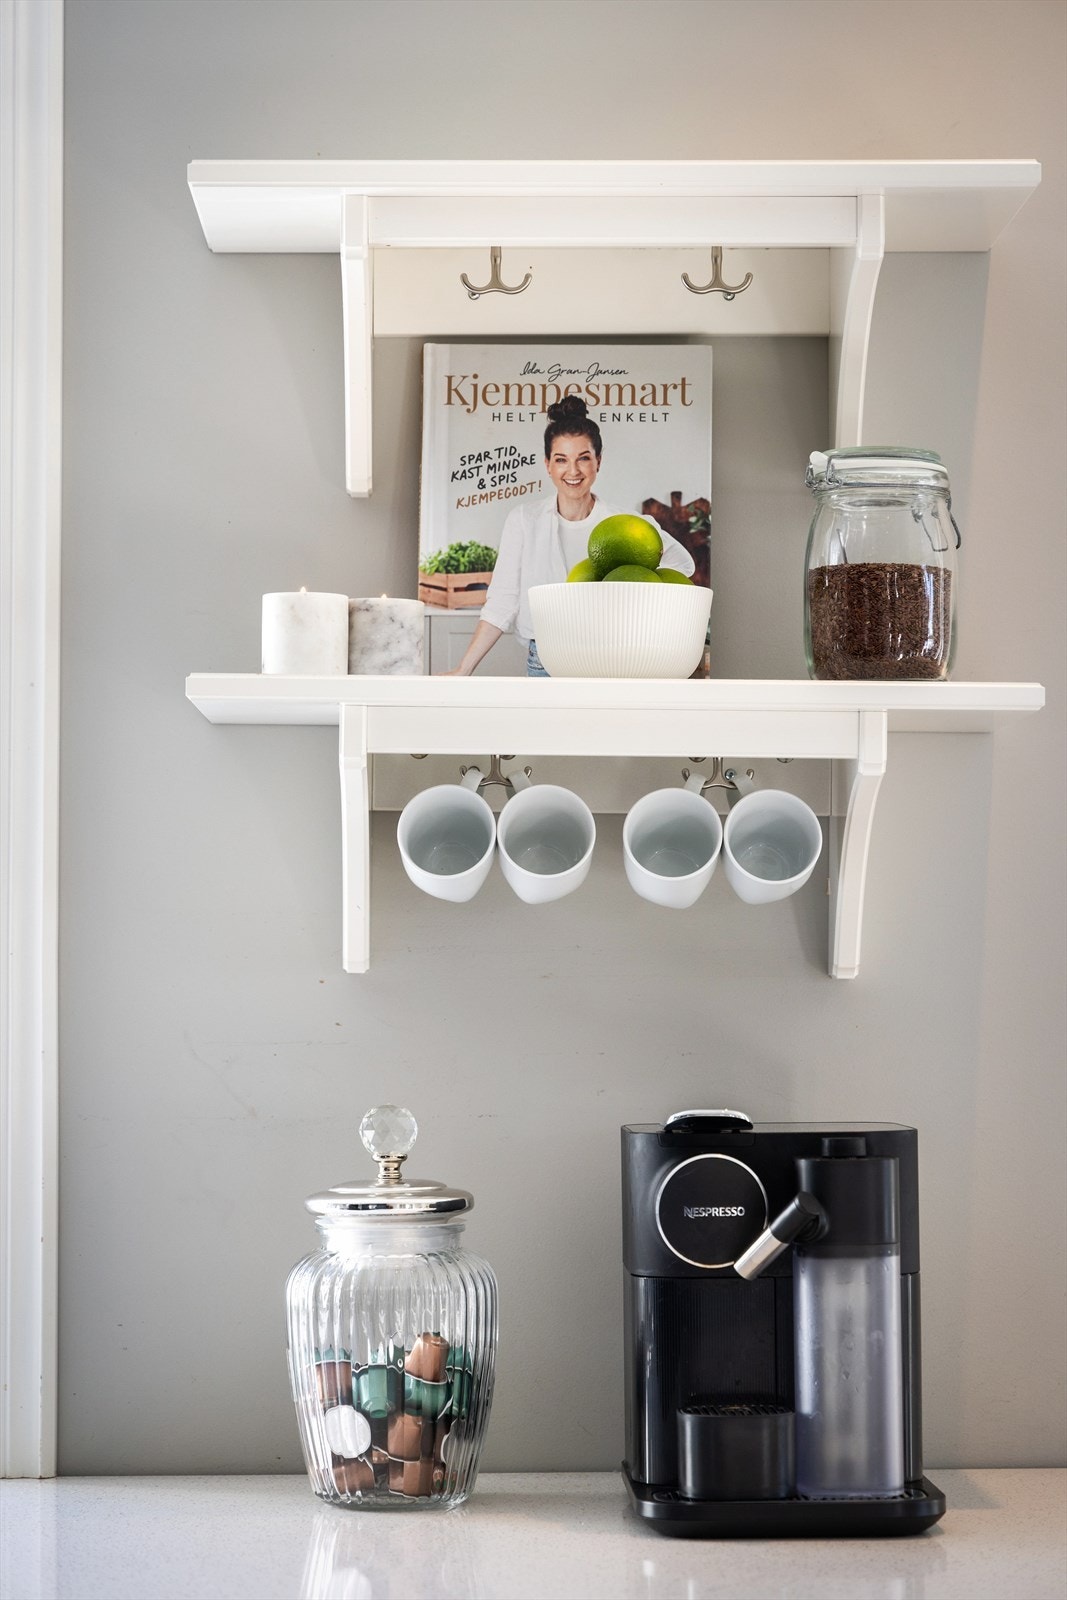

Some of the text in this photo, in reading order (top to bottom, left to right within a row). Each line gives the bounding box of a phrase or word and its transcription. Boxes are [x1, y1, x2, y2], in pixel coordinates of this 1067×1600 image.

[519, 361, 545, 376] Ida
[443, 373, 694, 414] Kjempesmart
[492, 412, 670, 422] HELT ENKELT
[459, 445, 521, 466] SPAR TID,
[450, 453, 536, 482] KAST MINDRE
[477, 471, 518, 490] & SPIS
[456, 479, 542, 509] KJEMPEGODT!
[683, 1205, 746, 1219] NESPRESSO
